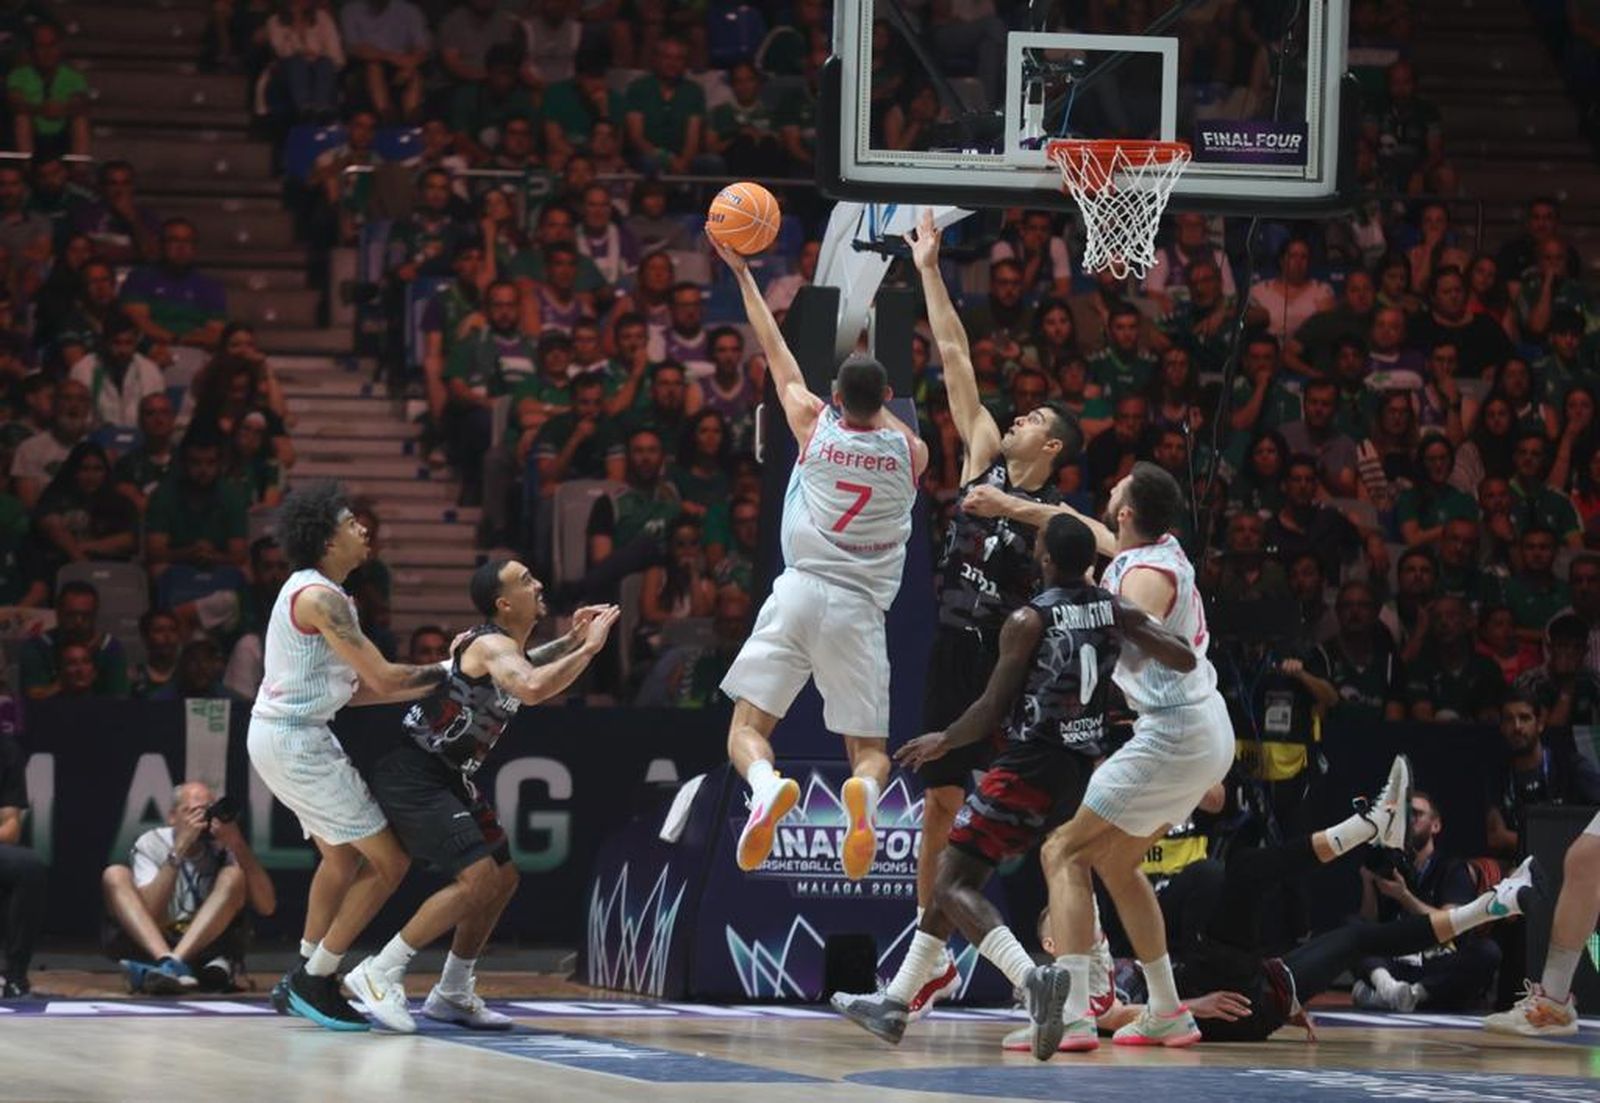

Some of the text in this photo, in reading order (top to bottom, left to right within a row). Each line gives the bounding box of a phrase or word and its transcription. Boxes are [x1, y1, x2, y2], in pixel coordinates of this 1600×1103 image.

[1202, 132, 1302, 149] FINAL FOUR
[819, 442, 897, 472] Herrera
[832, 480, 873, 534] 7
[1079, 643, 1099, 705] 0
[871, 882, 914, 896] 2023
